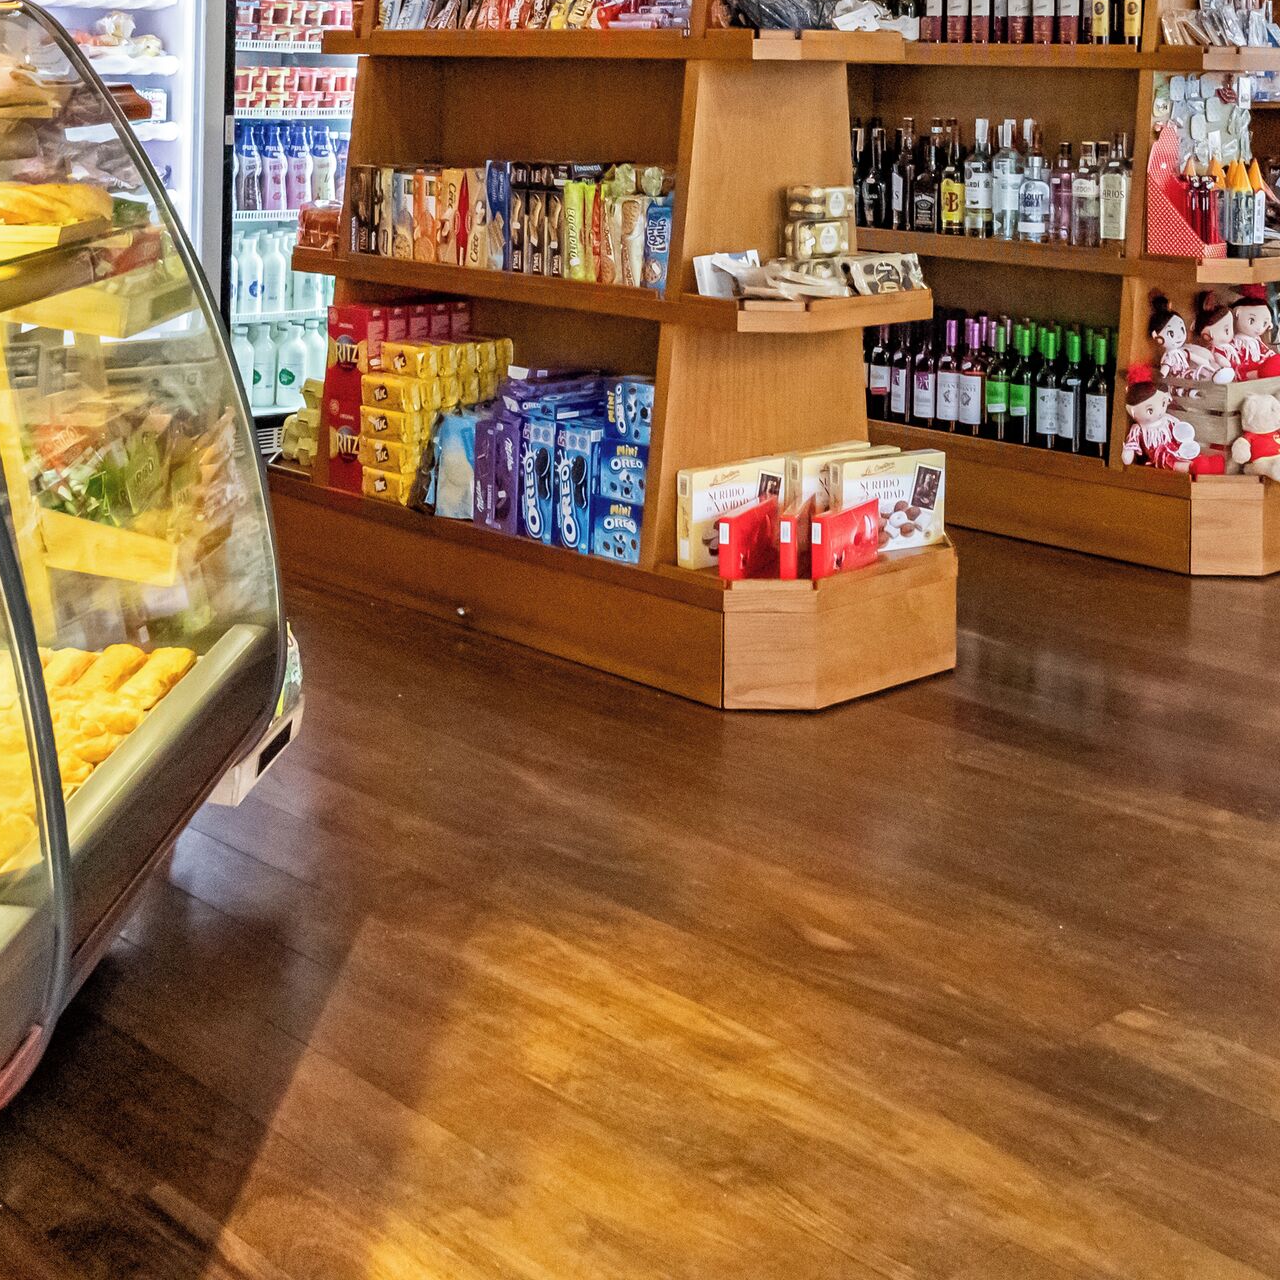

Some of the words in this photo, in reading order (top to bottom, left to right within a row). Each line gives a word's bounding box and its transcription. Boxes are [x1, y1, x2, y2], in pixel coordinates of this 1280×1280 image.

[1102, 189, 1125, 199] ARIOS
[335, 342, 359, 363] RITZ
[615, 384, 627, 434] OREO
[335, 434, 360, 454] RITZ
[610, 457, 644, 470] OREO
[708, 486, 745, 501] SURTIDO
[860, 477, 900, 491] SURTIDO
[523, 456, 541, 538] OREO
[560, 465, 577, 547] OREO
